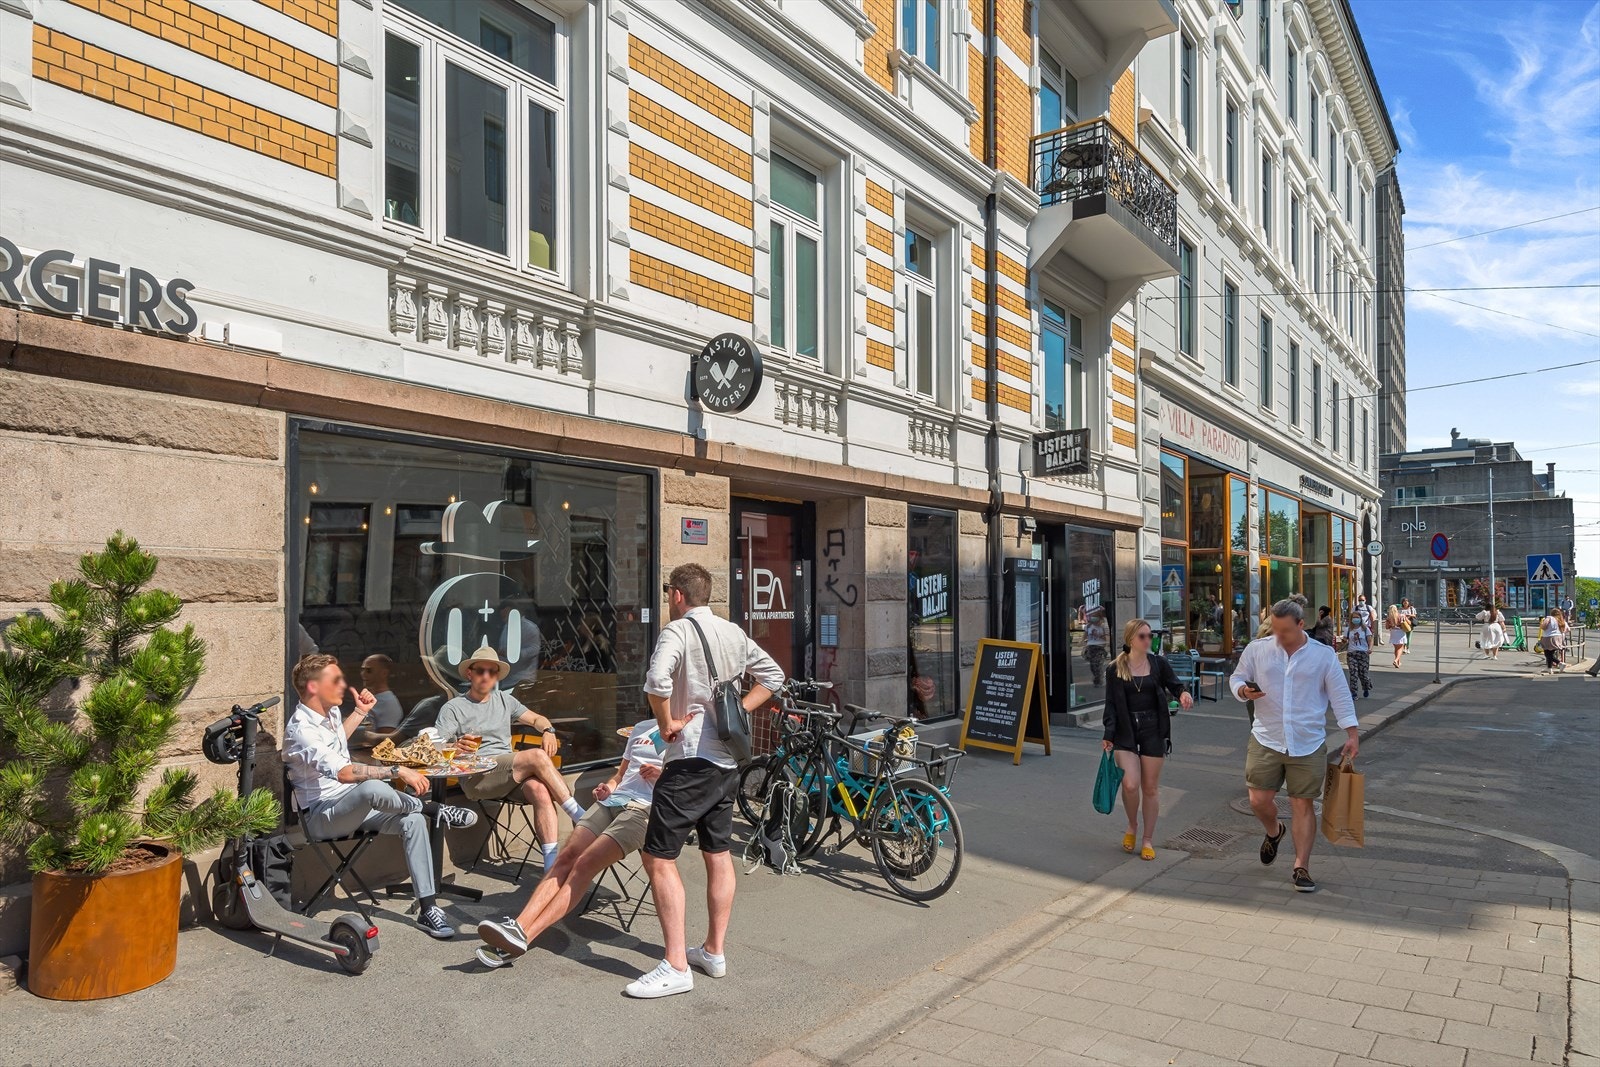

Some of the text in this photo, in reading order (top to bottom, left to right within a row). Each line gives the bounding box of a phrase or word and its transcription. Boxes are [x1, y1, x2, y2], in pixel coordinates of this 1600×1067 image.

[703, 338, 746, 362] BASTARD
[703, 383, 746, 406] BURGERS
[1167, 404, 1240, 461] VILLA PARADISO
[1038, 434, 1074, 455] LISTEN
[1046, 447, 1081, 468] BALJIT
[917, 573, 942, 598] LISTEN
[922, 592, 948, 617] BALJIT
[995, 651, 1014, 659] LISTEN
